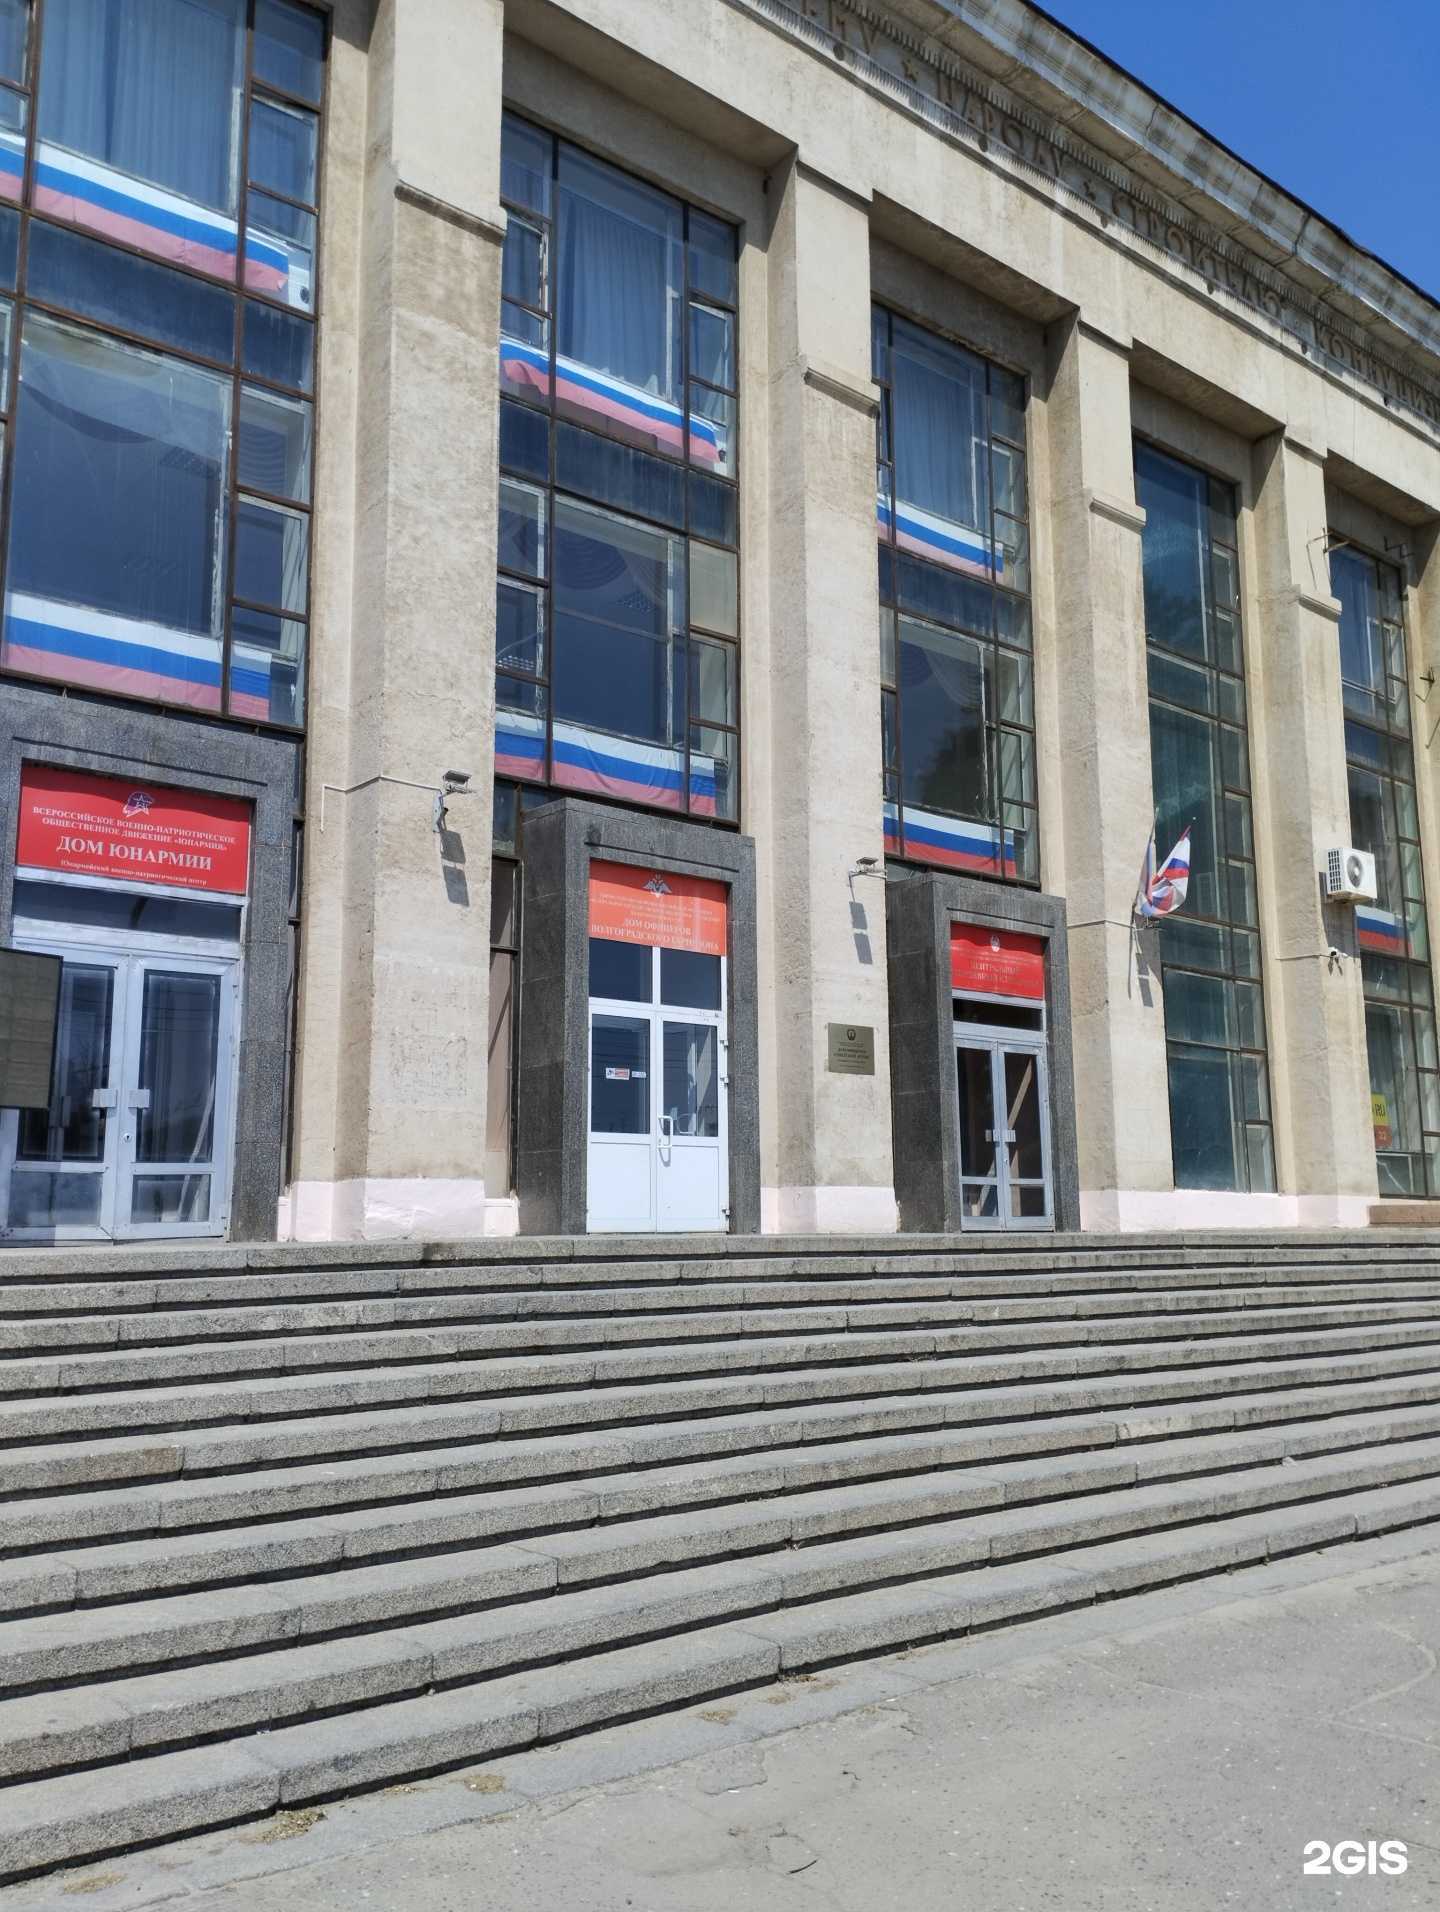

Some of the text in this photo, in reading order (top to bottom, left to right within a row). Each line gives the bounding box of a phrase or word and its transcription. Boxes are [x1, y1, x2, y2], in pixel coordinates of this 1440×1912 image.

[33, 806, 236, 845] ВСЕРОССИЙСКОЕ ВОЕННО-ПАТРИОТИЧЕСКОЕ
[42, 817, 120, 836] ОБЩЕСТВЕННОЕ
[121, 829, 172, 844] ДВИЖЕНИЕ
[56, 835, 212, 871] ДОМ ЮНАРМИИ
